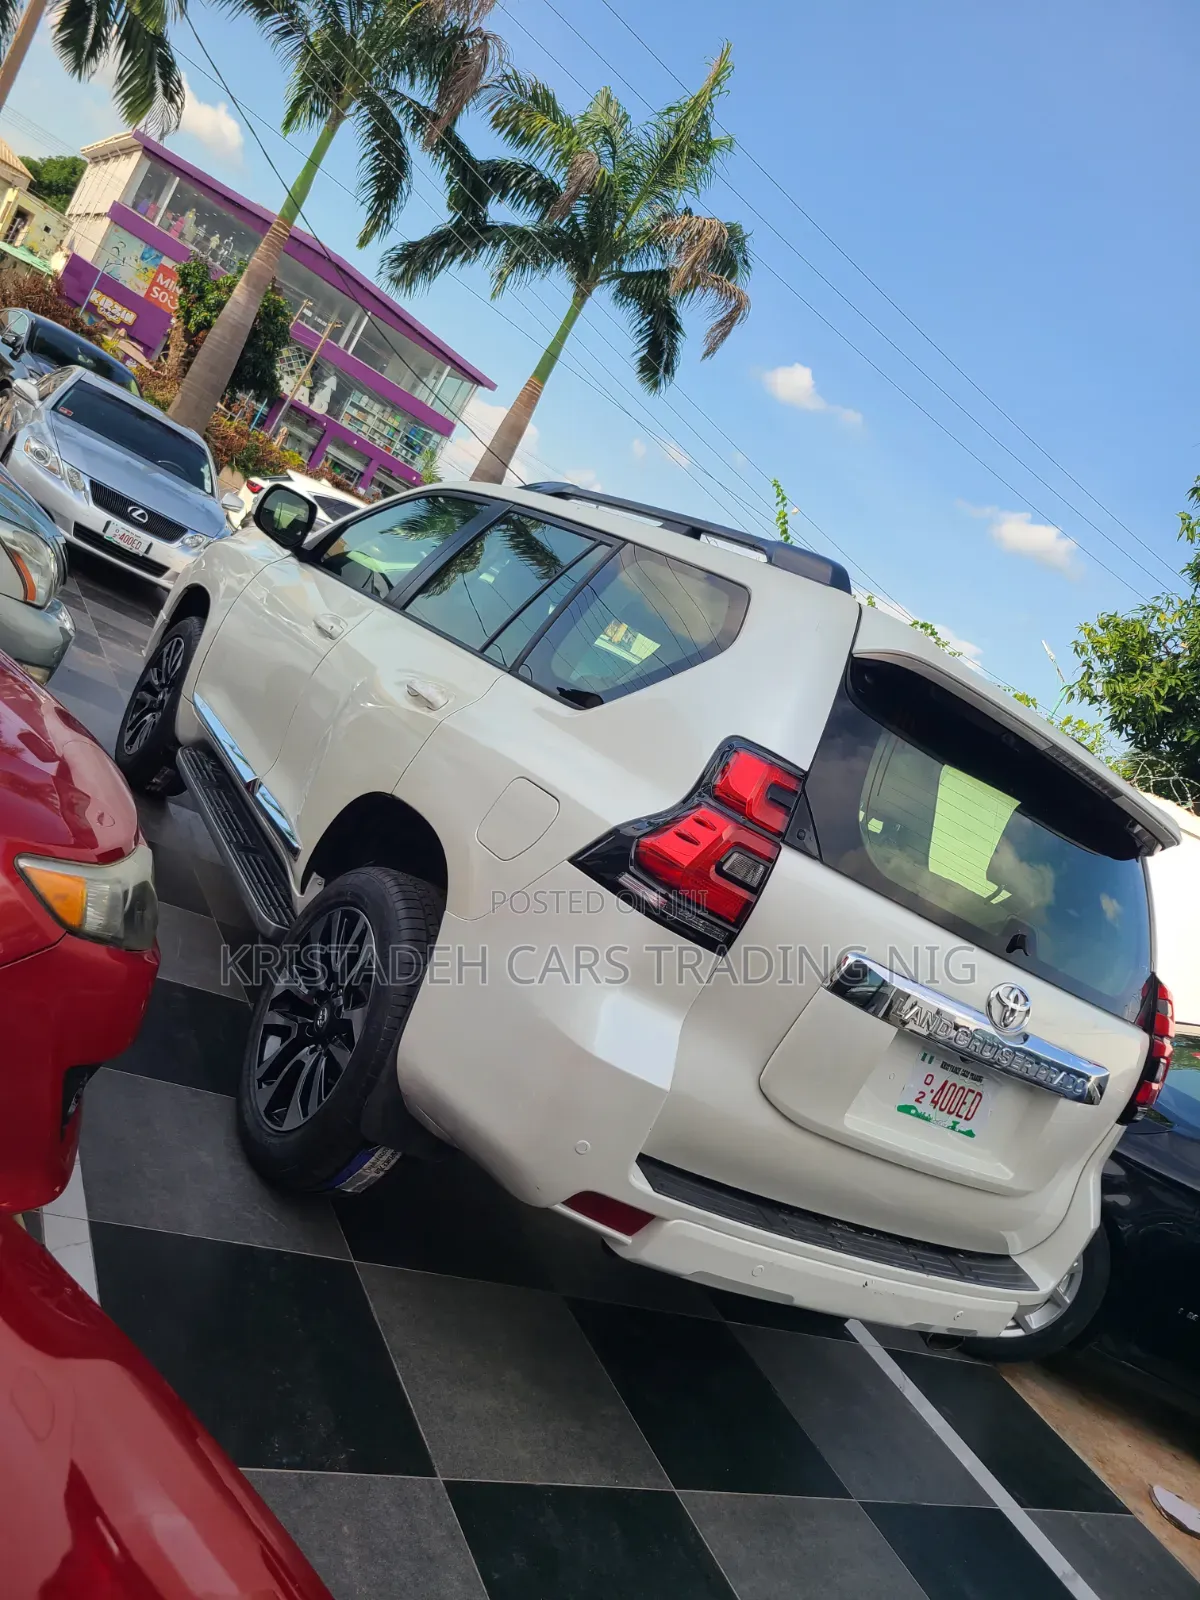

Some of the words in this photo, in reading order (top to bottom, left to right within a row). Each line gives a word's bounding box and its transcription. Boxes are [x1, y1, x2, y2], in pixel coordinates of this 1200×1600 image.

[893, 998, 954, 1039] LAND
[953, 1026, 1035, 1075] CRUISER
[1034, 1062, 1088, 1095] PRADO
